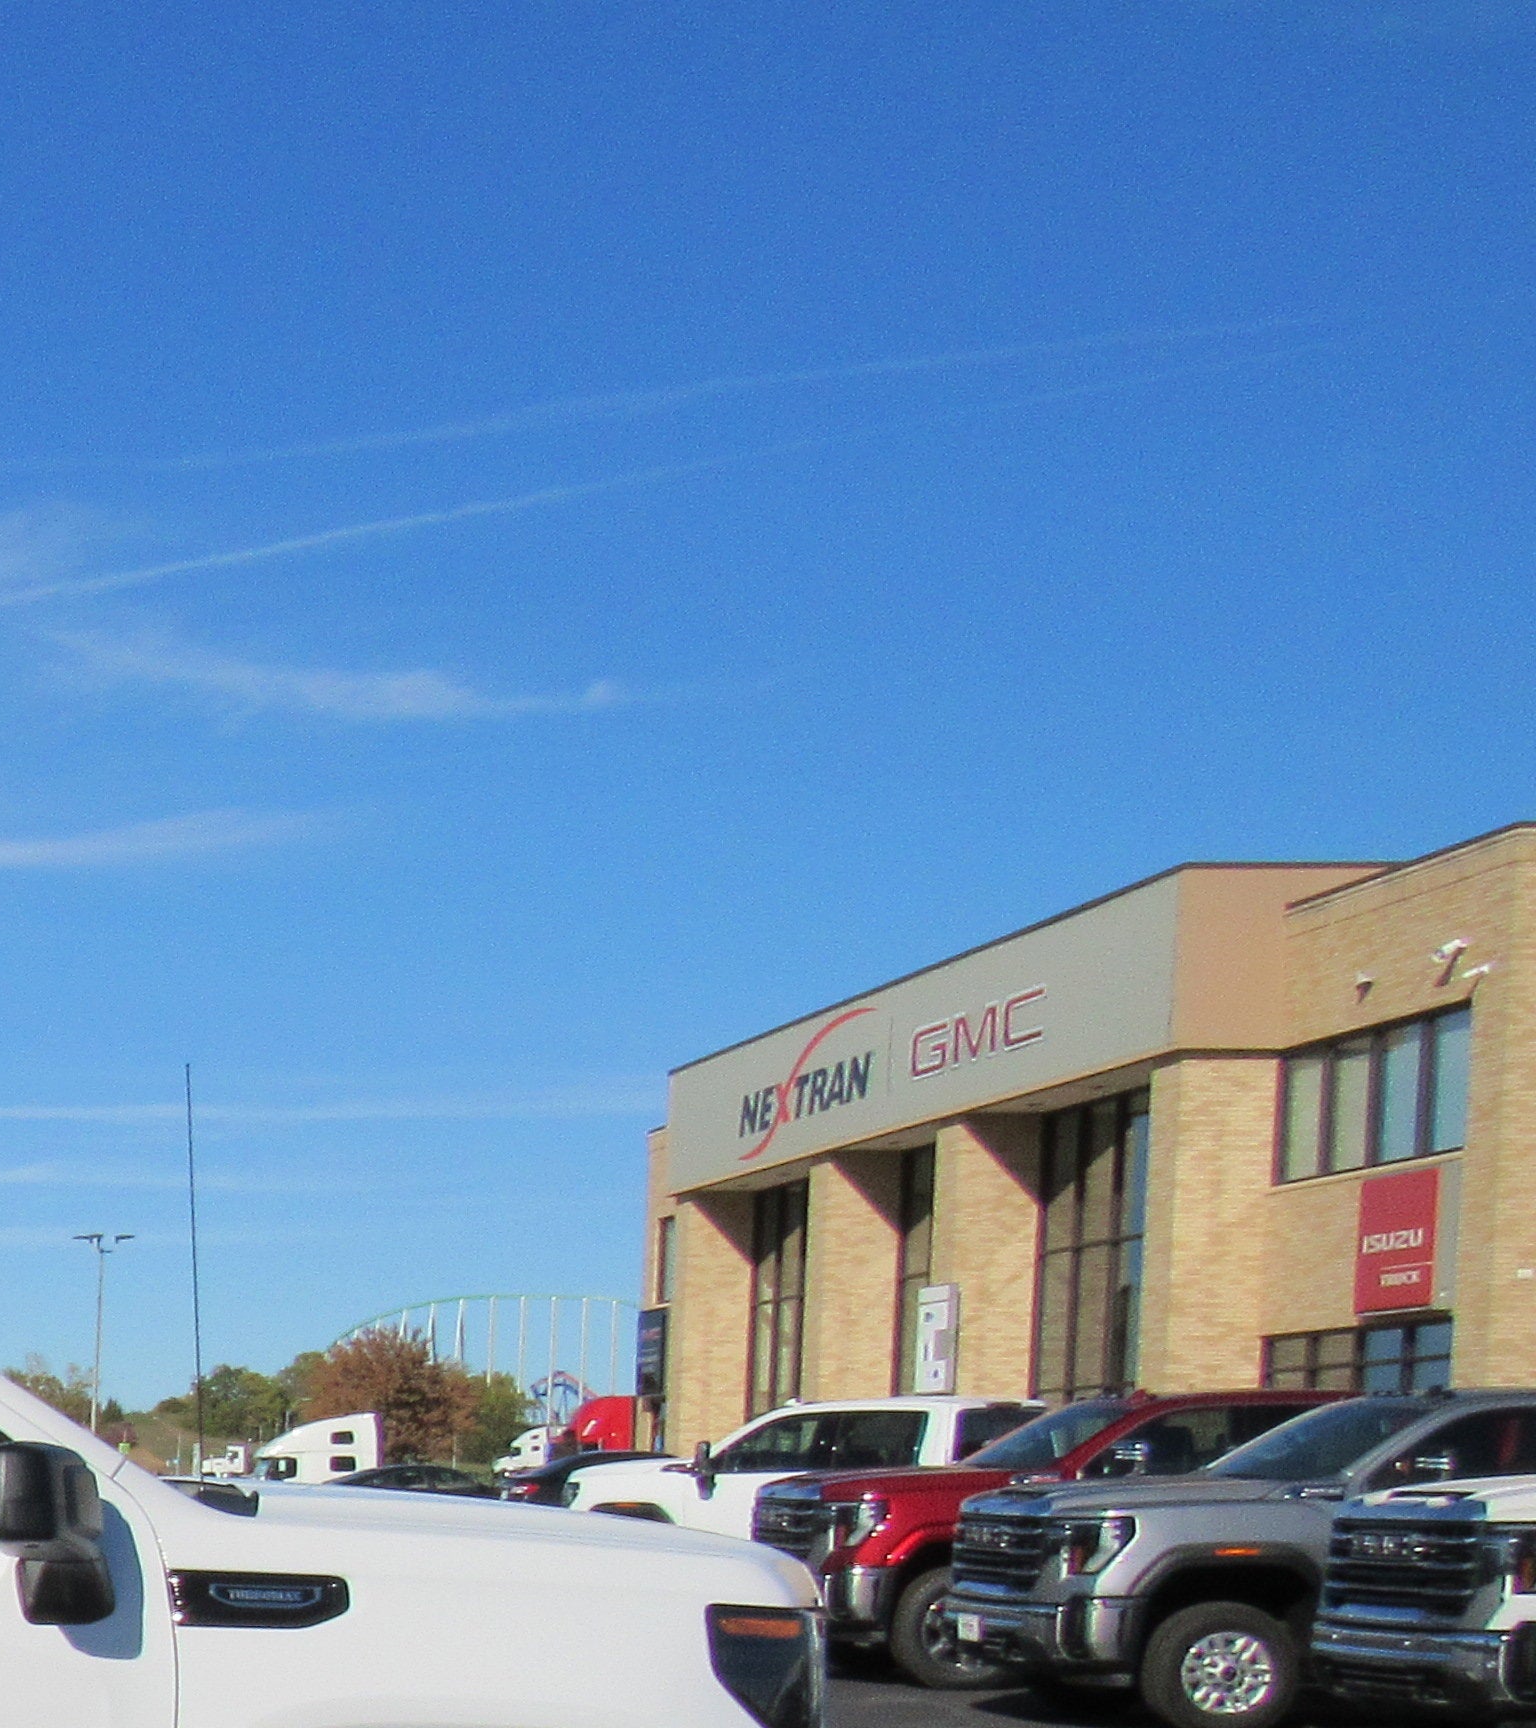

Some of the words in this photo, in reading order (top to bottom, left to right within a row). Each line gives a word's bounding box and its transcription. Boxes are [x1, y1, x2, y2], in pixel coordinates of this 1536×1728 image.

[910, 984, 1046, 1081] GMC
[738, 1042, 874, 1144] NEXTRAN
[1361, 1228, 1424, 1254] ISUZU
